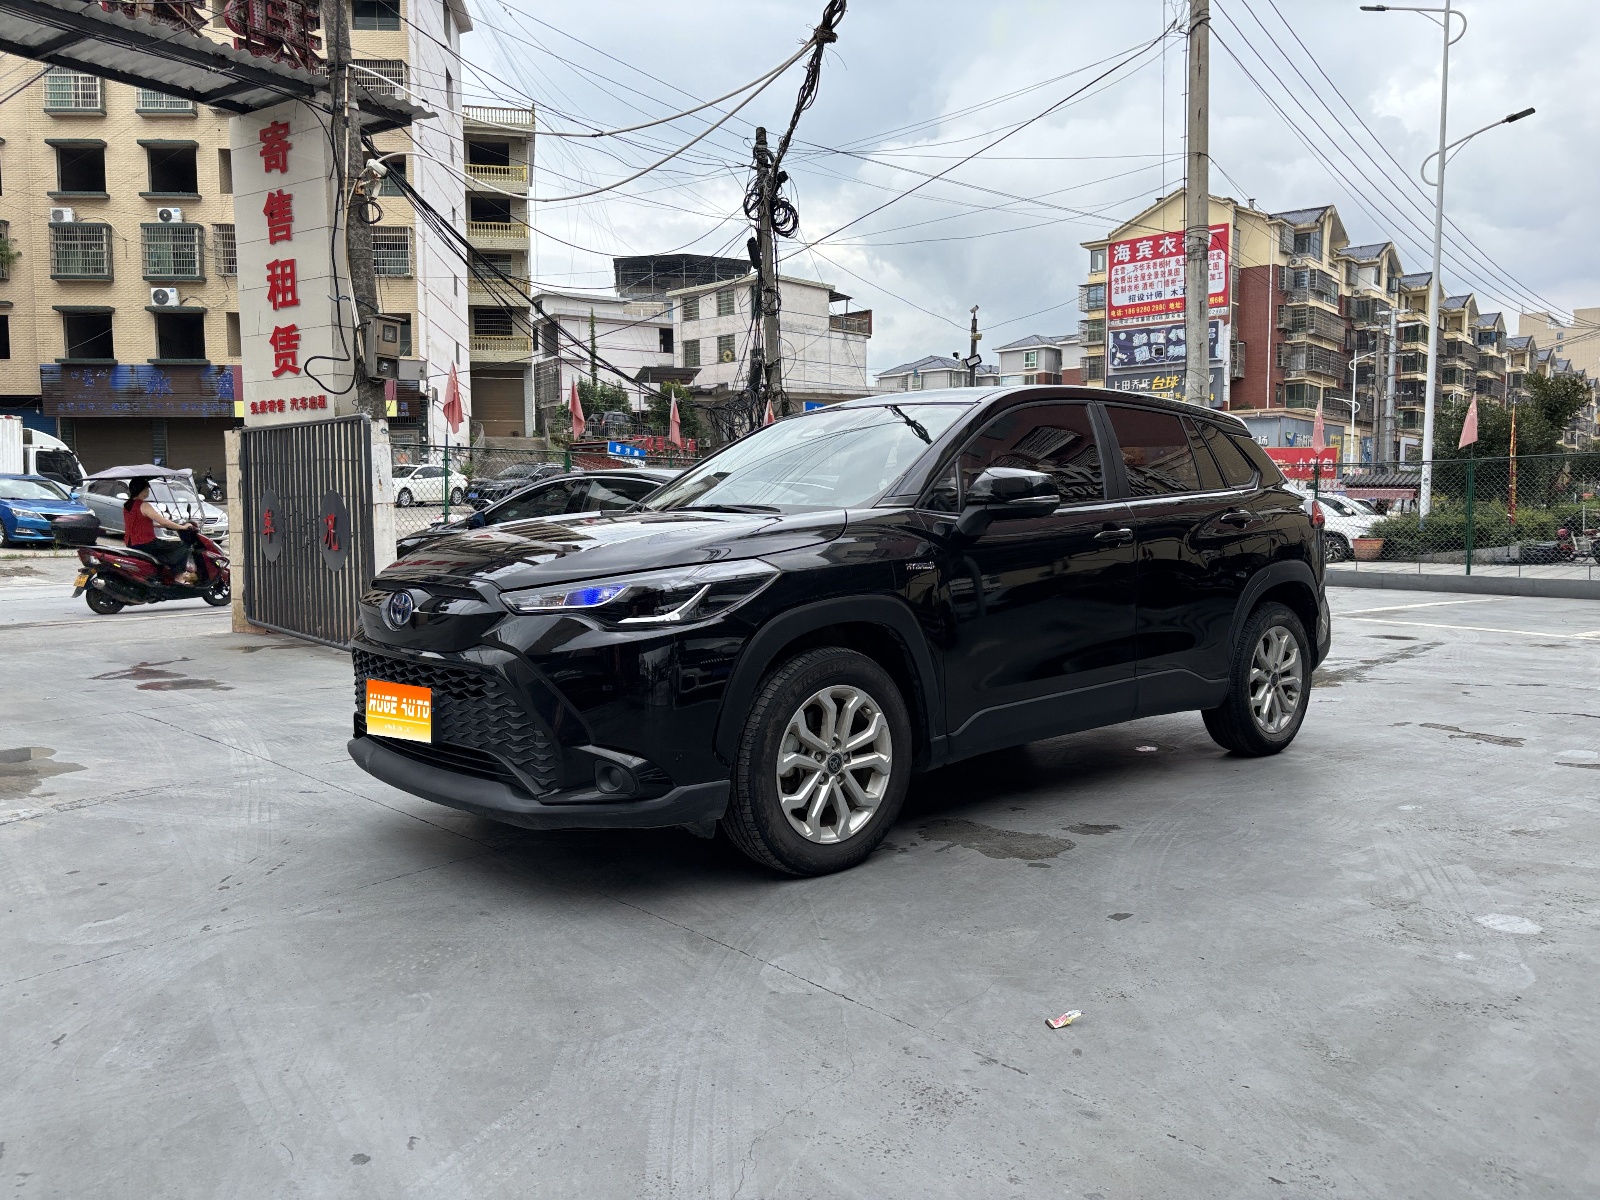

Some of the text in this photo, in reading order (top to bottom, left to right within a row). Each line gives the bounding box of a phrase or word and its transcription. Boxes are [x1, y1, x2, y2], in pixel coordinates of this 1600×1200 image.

[259, 120, 301, 378] 寄售租赁
[1128, 290, 1163, 303] 招设计师
[290, 394, 327, 411] 汽车出租
